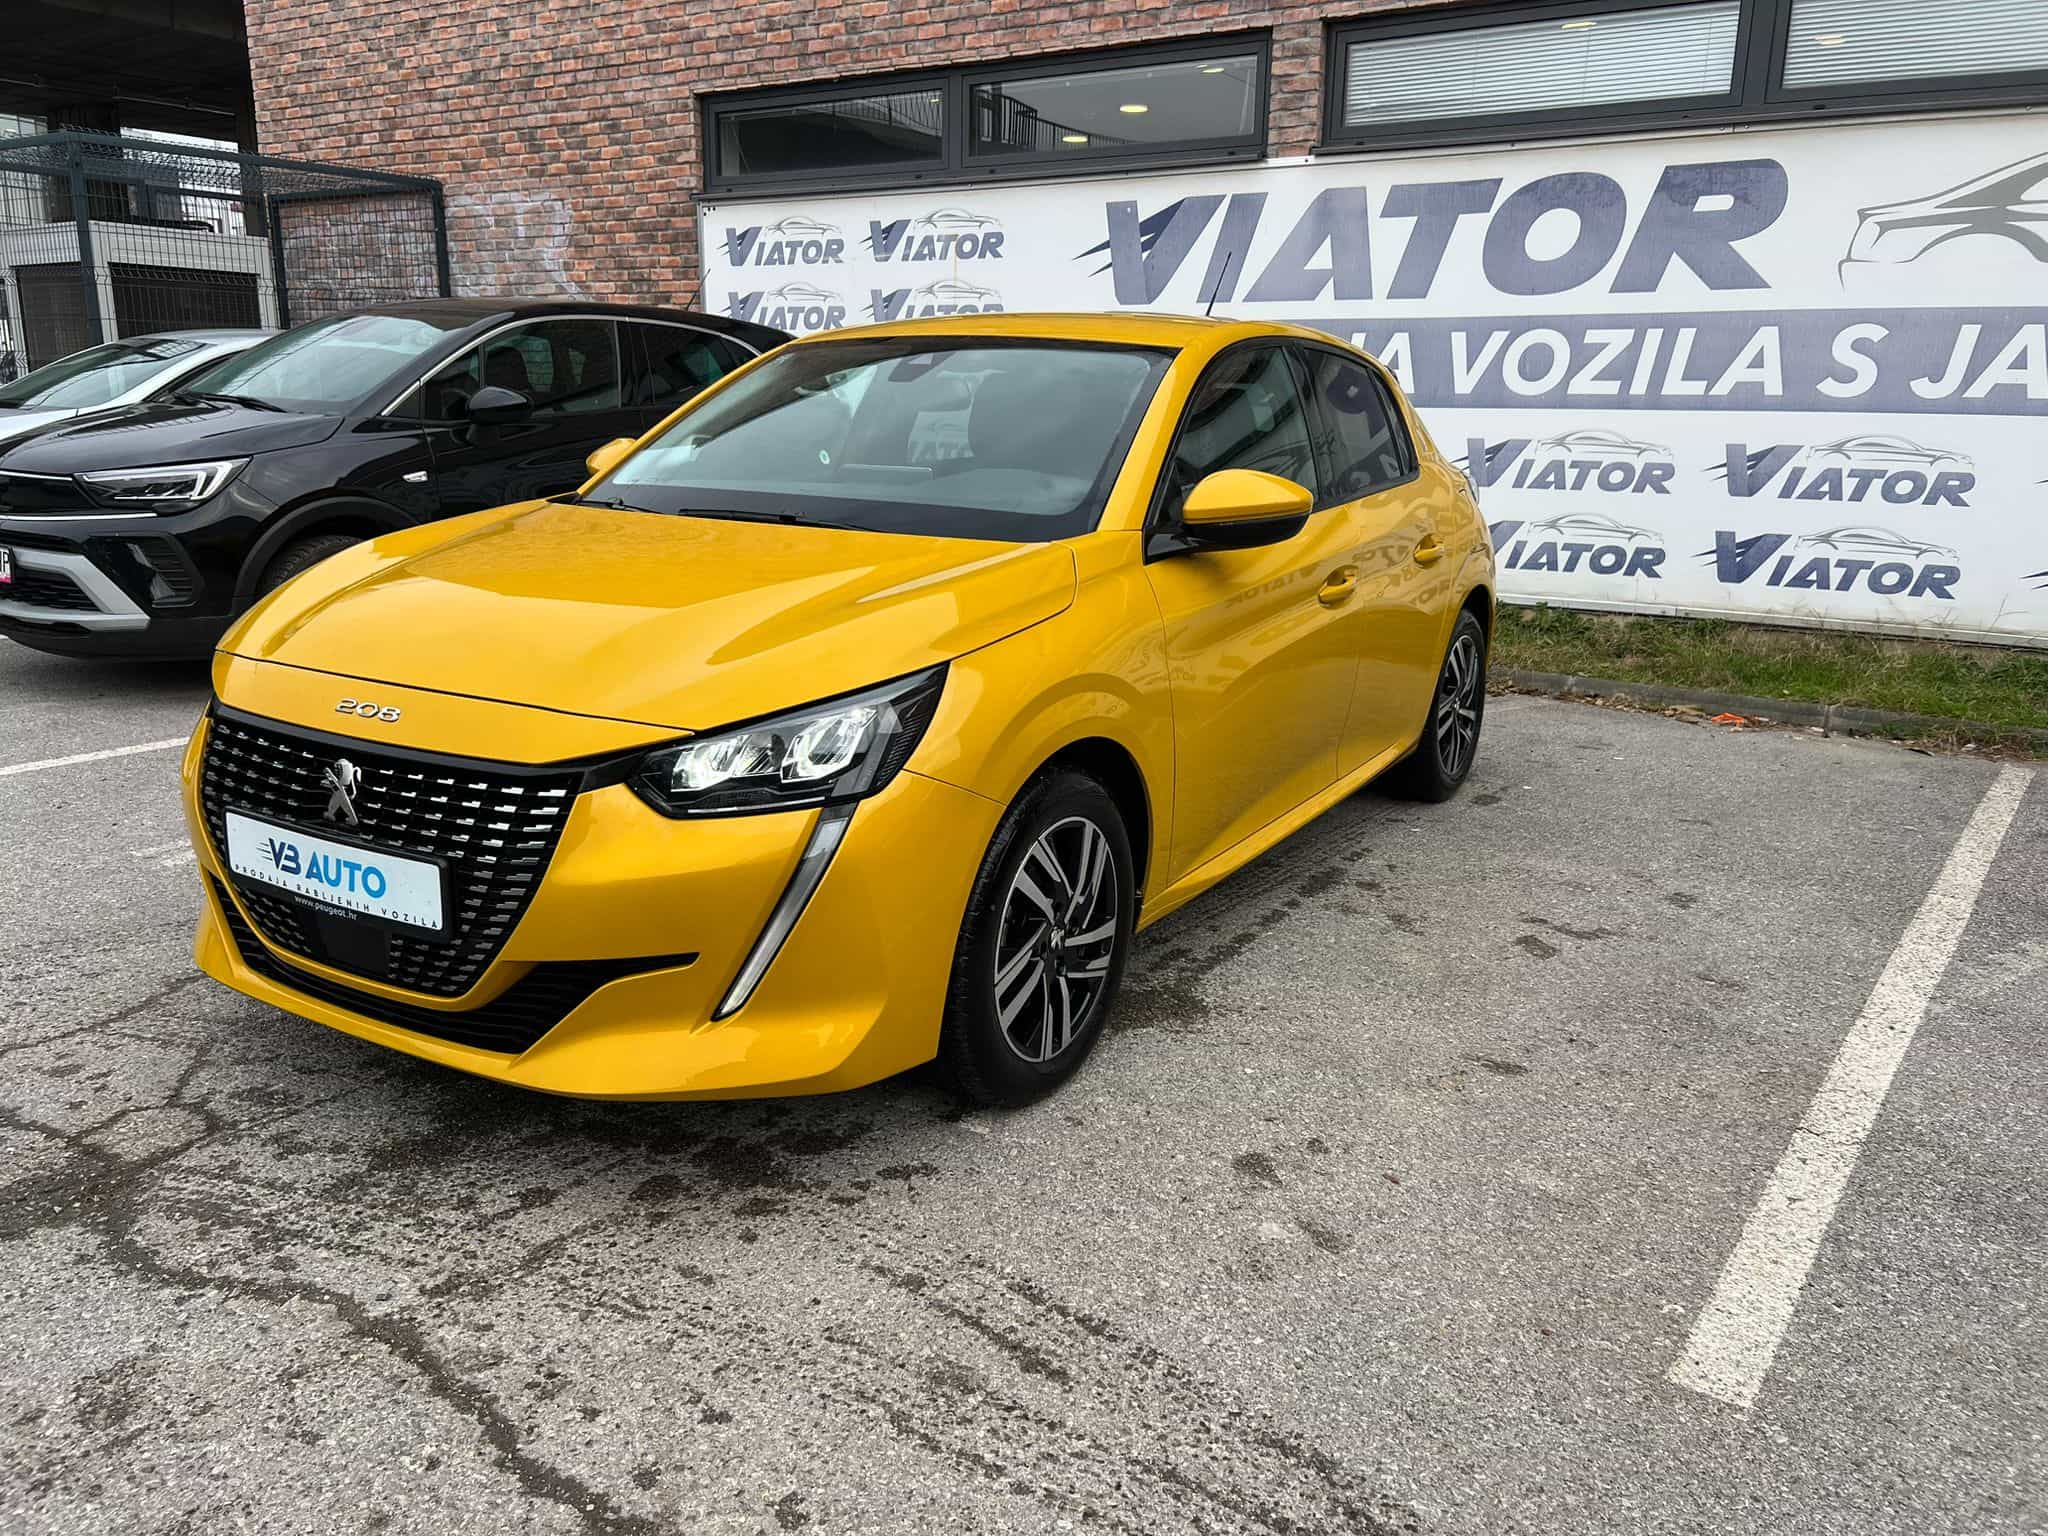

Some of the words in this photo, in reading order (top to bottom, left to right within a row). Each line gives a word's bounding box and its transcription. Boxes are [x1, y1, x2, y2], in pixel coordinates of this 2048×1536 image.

[726, 226, 845, 266] VIATOR
[869, 219, 1004, 262] VIATOR
[1106, 158, 1788, 304] VIATOR
[1451, 327, 1784, 397] VOZILA
[1816, 322, 1890, 398] S
[1909, 323, 2048, 400] JA
[1467, 438, 1675, 494] VIATOR
[1723, 443, 1976, 507] VIATOR
[1713, 530, 1961, 600] VIATOR
[335, 698, 401, 722] 208
[305, 852, 386, 898] AUTO
[294, 895, 358, 921] www.peugeot.hr
[381, 907, 438, 929] VOZILA
